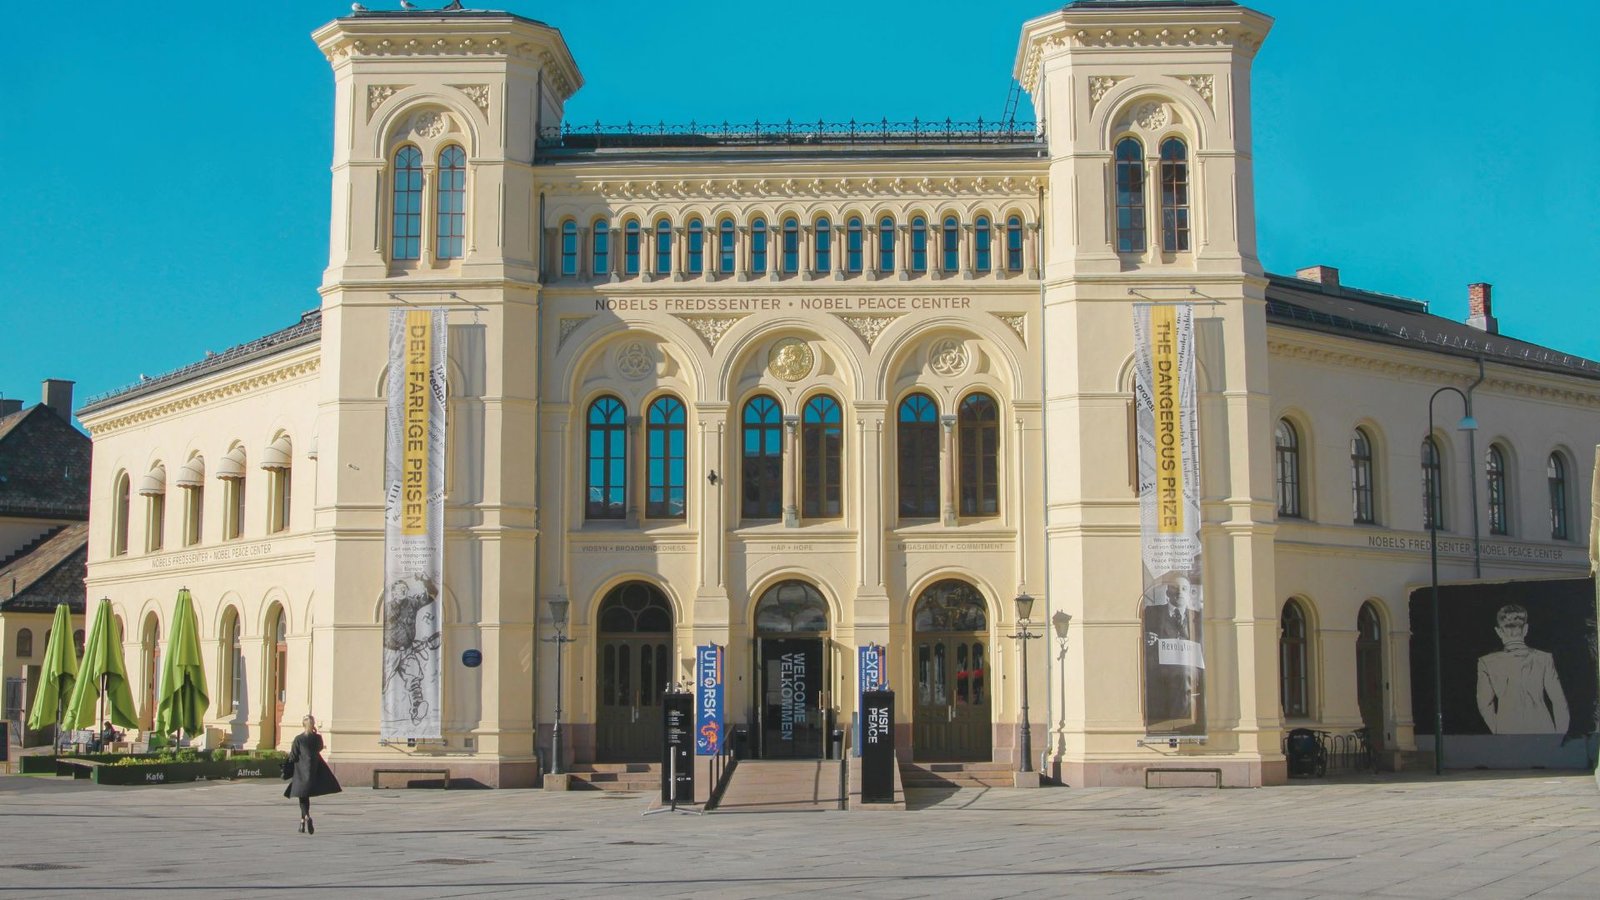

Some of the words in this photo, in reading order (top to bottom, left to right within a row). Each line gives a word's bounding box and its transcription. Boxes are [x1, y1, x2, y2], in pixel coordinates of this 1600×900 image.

[595, 299, 659, 311] NOBELS
[665, 298, 782, 310] FREDSSENTER
[800, 298, 853, 310] NOBEL
[858, 298, 907, 309] PEACE
[911, 297, 971, 309] CENTER
[410, 325, 427, 365] DEN
[1157, 321, 1172, 355] THE
[408, 371, 425, 452] FARLIGE
[1158, 360, 1177, 471] DANGEROUS
[406, 458, 423, 529] PRISEN
[1162, 477, 1178, 528] PRIZE
[152, 557, 172, 569] NOBELS
[213, 550, 231, 560] NOBEL
[232, 546, 249, 558] PEACE
[250, 543, 272, 556] CENTER
[1368, 536, 1406, 549] NOBELS
[1408, 539, 1471, 553] FREDSENTER
[1480, 544, 1507, 556] NOBEL
[1507, 546, 1533, 558] PEACE
[1534, 549, 1563, 560] CENTER
[703, 650, 717, 719] UTFORSK
[781, 652, 793, 740] VELKOMMEN
[793, 652, 806, 724] WELCOME
[868, 707, 879, 744] PEACE
[878, 707, 889, 735] VISIT
[146, 772, 165, 781] Kafé
[237, 769, 262, 777] Alfred.
